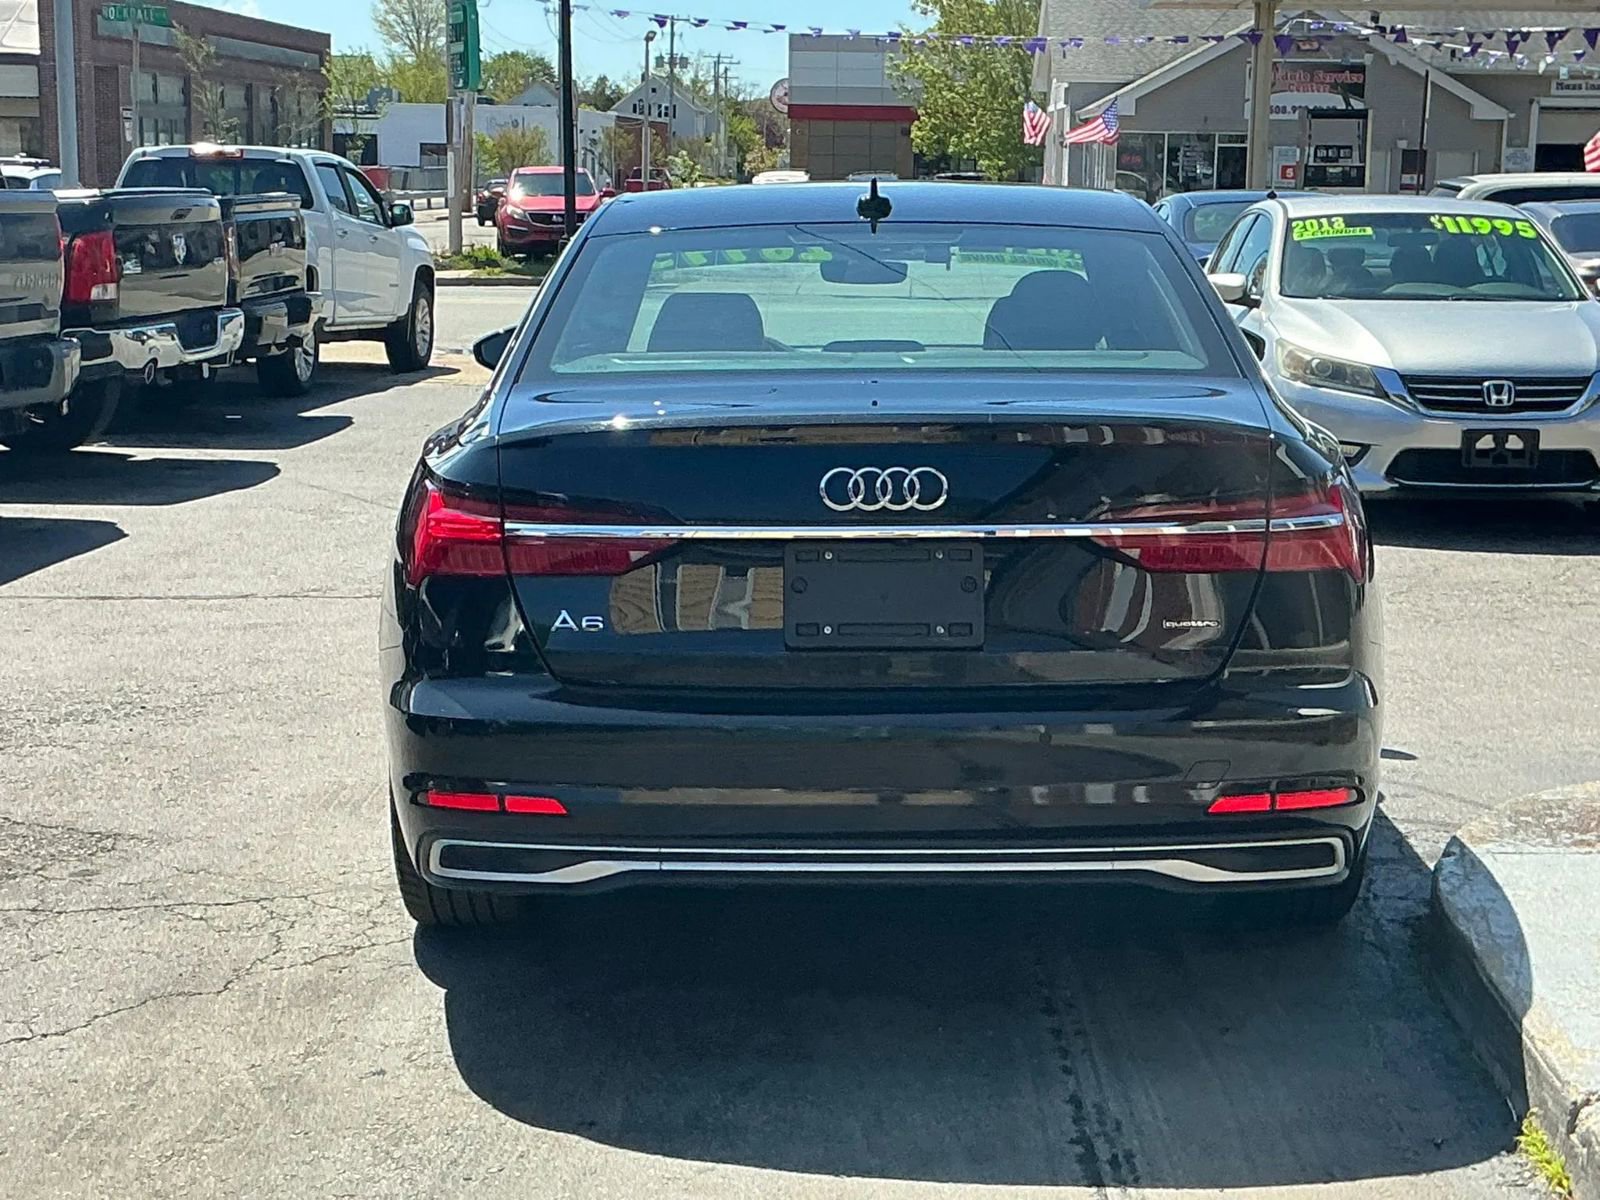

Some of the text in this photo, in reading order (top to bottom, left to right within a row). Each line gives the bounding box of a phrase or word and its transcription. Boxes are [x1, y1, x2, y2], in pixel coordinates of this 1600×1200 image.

[1313, 70, 1364, 83] Service
[1288, 83, 1330, 93] Center
[550, 610, 604, 631] A6
[1164, 620, 1219, 629] quattro
